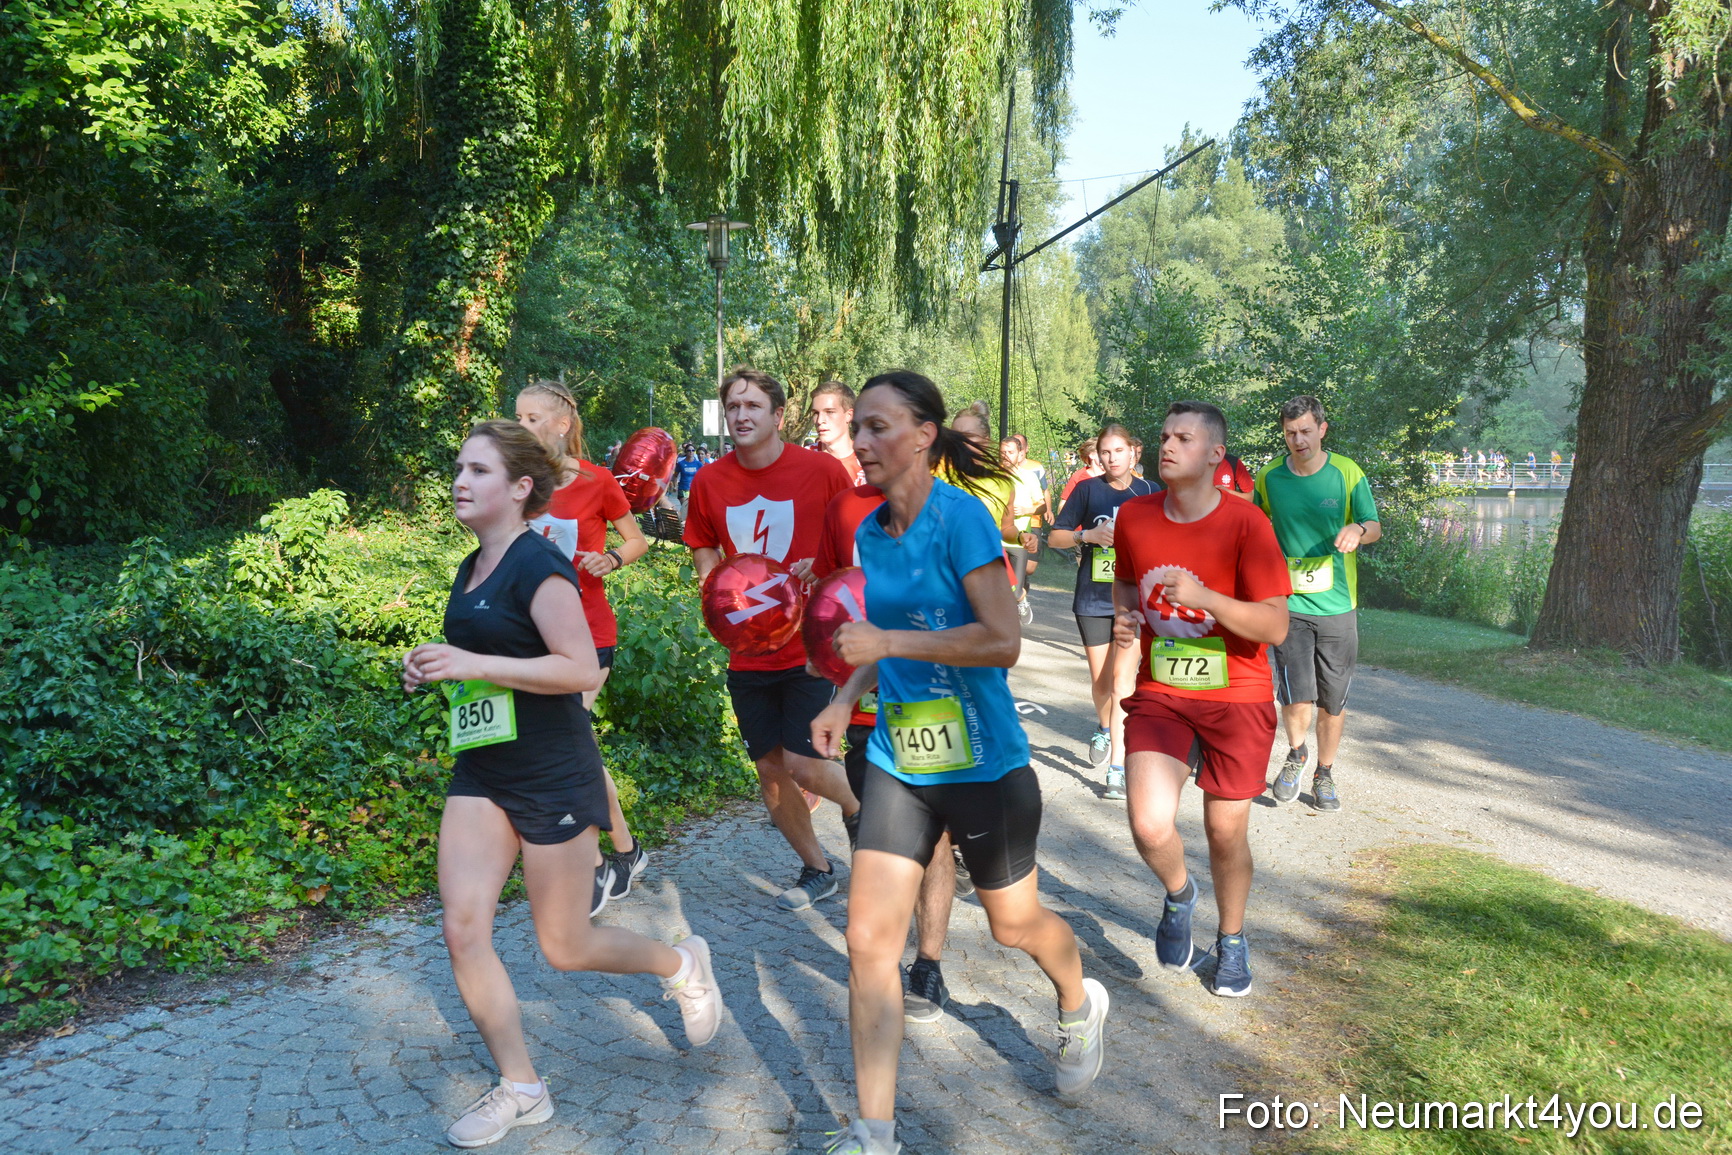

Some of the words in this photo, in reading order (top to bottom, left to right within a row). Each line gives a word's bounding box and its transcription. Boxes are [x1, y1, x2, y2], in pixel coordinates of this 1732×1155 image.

[1306, 570, 1315, 583] 5
[1166, 657, 1210, 676] 772
[458, 699, 494, 730] 850
[895, 724, 953, 753] 1401
[965, 701, 985, 767] Nathalies
